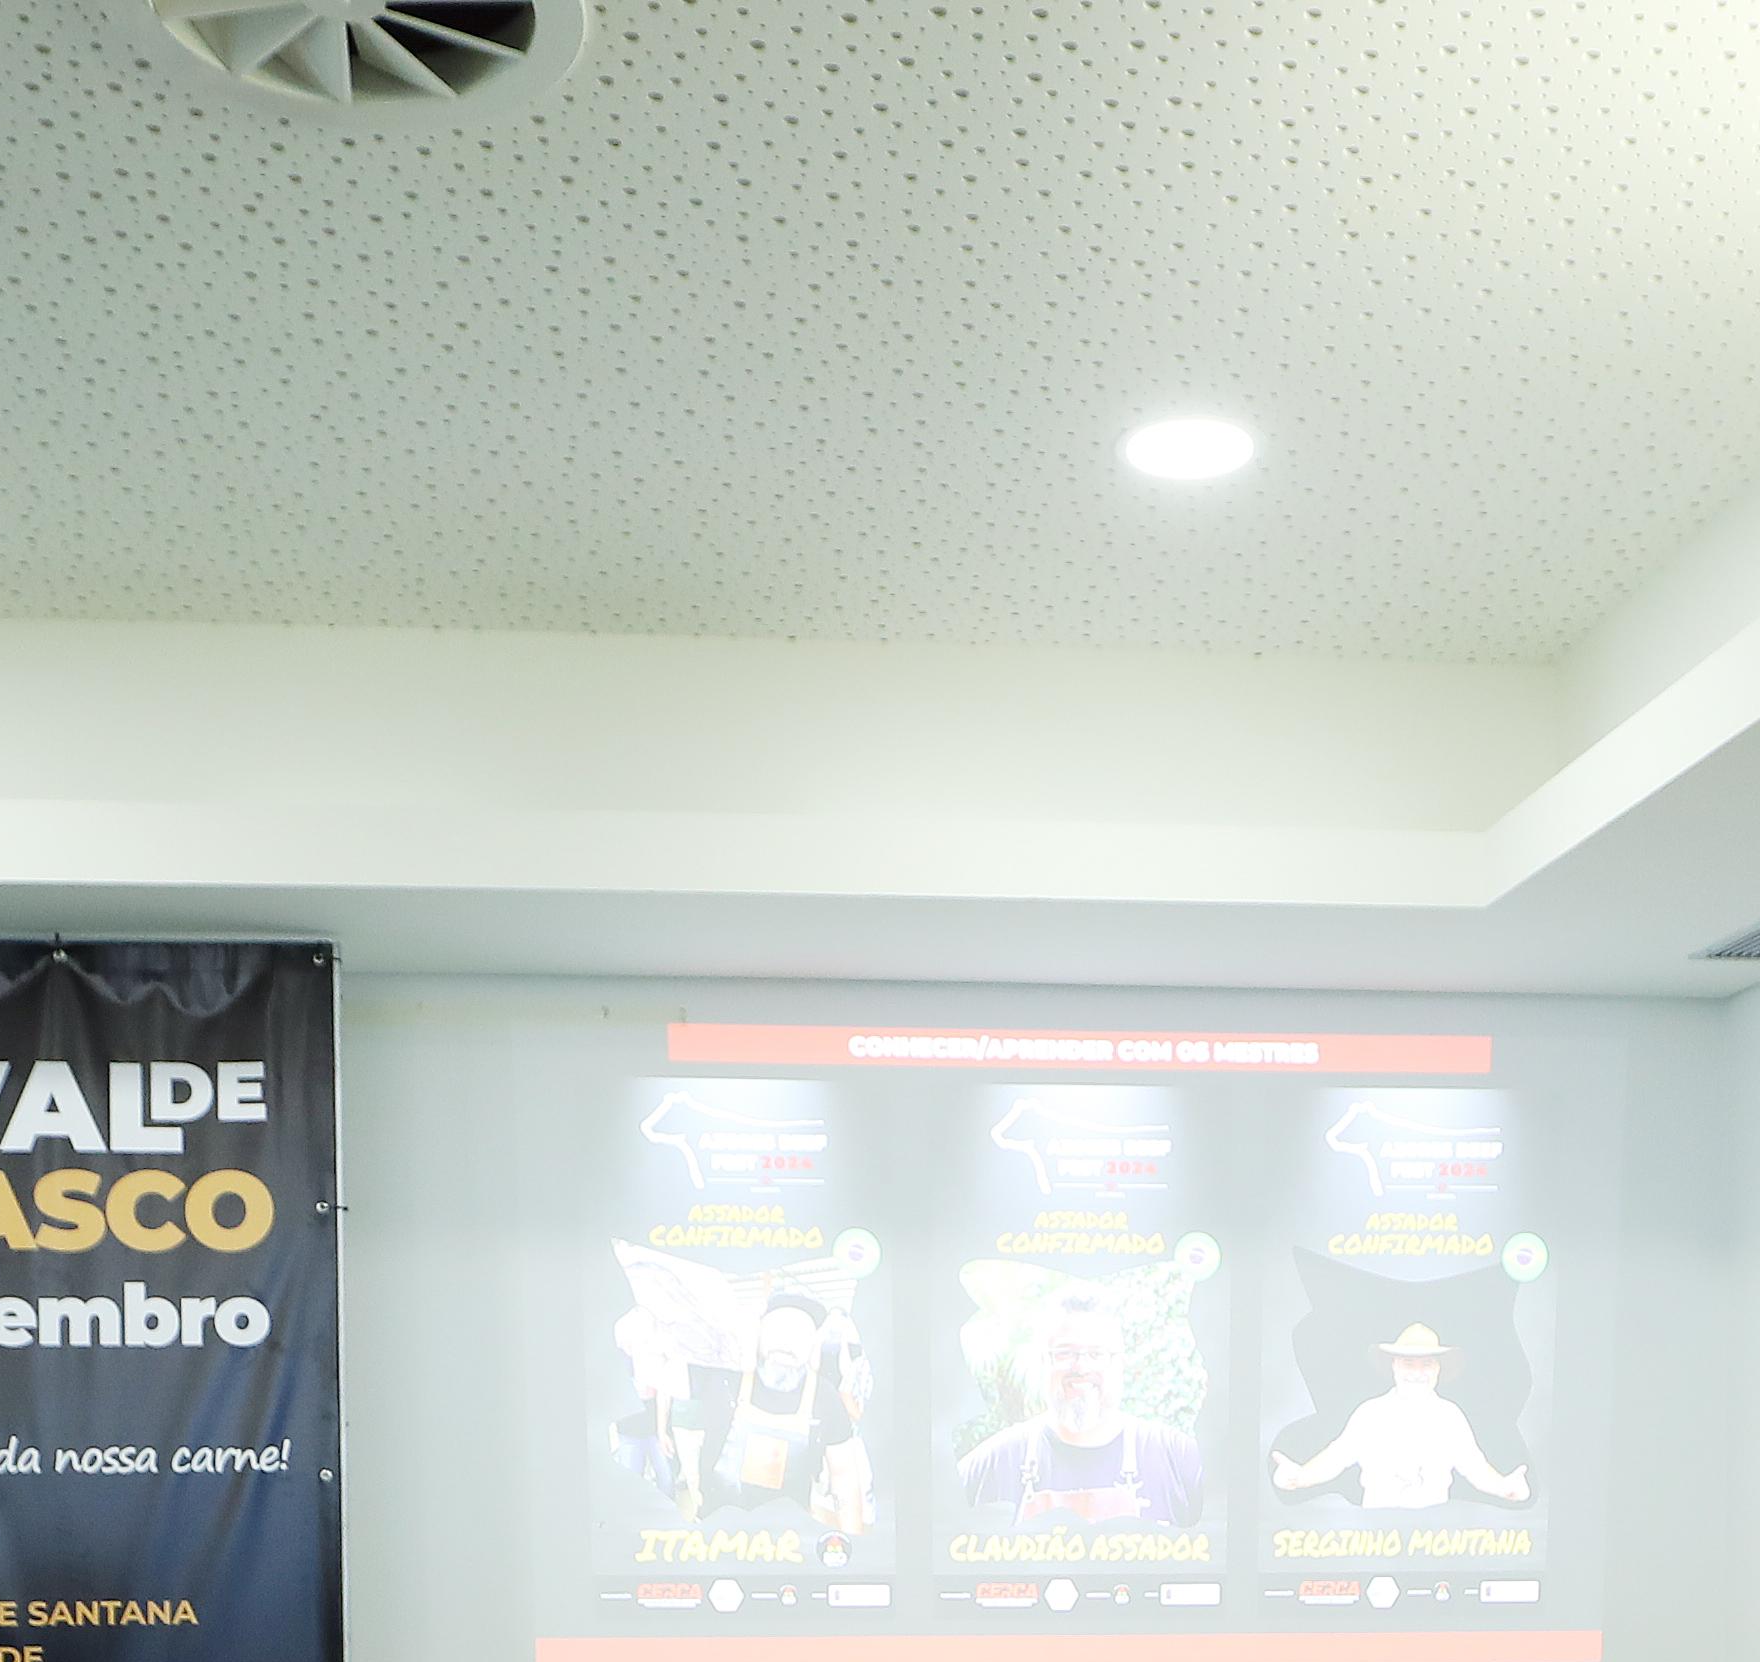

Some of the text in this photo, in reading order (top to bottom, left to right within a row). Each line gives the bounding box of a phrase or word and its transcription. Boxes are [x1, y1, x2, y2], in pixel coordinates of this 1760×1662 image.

[1121, 1041, 1172, 1062] COM
[1177, 1042, 1209, 1063] OS
[1214, 1041, 1320, 1065] MESTRES
[150, 1061, 269, 1124] DE
[687, 1204, 786, 1225] ASSADOR
[1033, 1210, 1130, 1231] ASSADOR
[1364, 1212, 1459, 1234] ASSADOR
[648, 1223, 825, 1250] CONFIRMADO
[995, 1230, 1167, 1256] CONFIRMADO
[1327, 1231, 1496, 1257] CONFIRMADO
[55, 1446, 160, 1477] nossa
[171, 1438, 292, 1476] carne!
[634, 1529, 805, 1563] ITAMAR
[948, 1525, 1212, 1563] CLAUDIÃO ASSADOR
[1272, 1529, 1534, 1559] SERGINHO MONTANA
[27, 1599, 199, 1628] SANTANA
